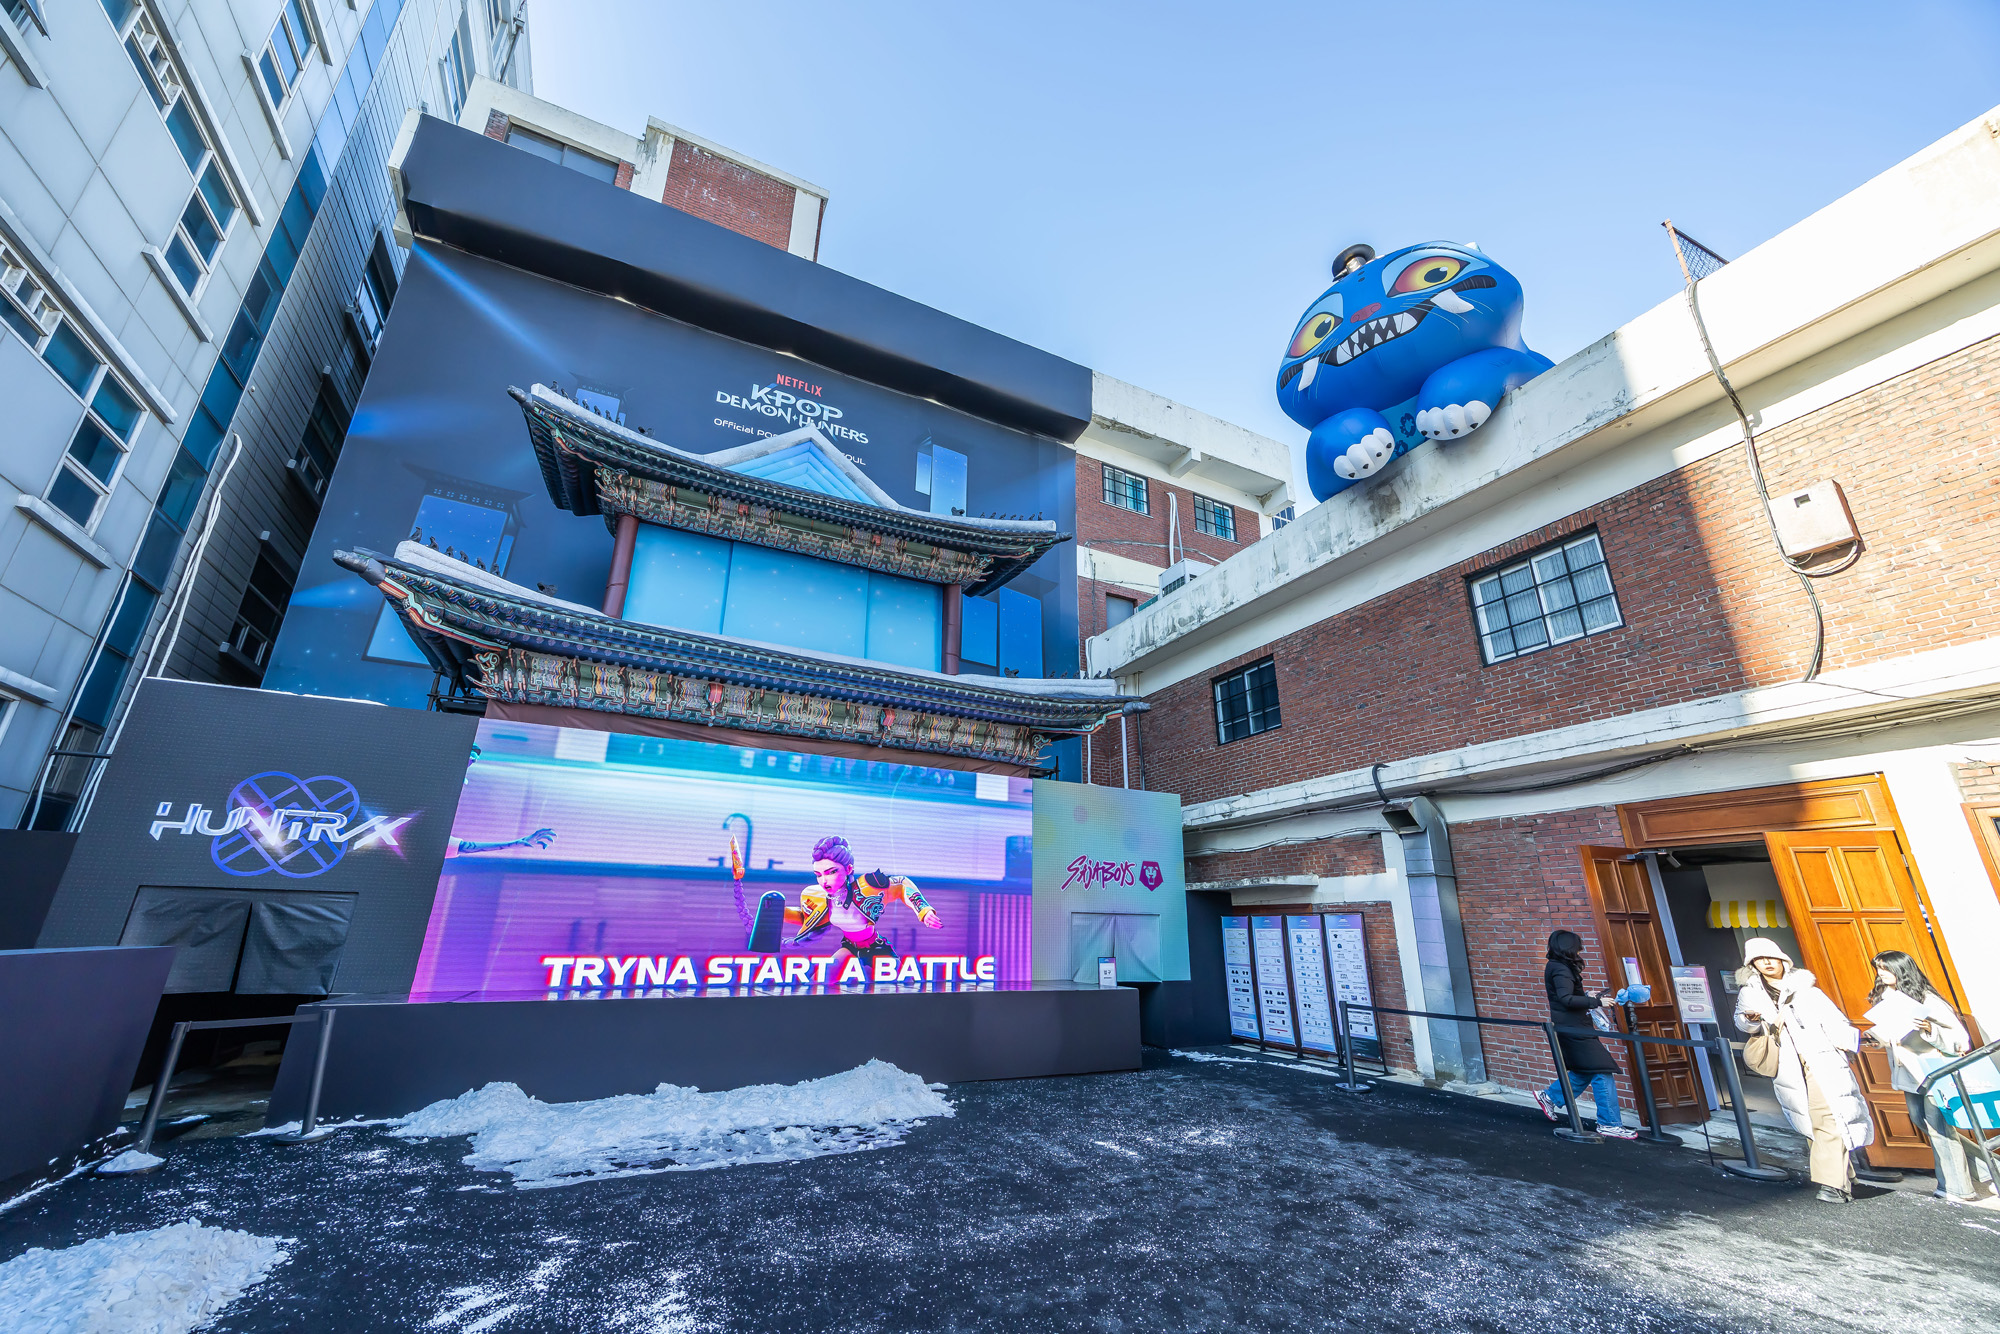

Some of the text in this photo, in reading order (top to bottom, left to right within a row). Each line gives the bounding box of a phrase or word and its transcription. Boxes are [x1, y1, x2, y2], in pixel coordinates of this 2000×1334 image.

[776, 373, 822, 397] NETFLIX
[716, 391, 869, 444] DEMON HUNTERS
[541, 955, 995, 987] TRYNA START A BATTLE
